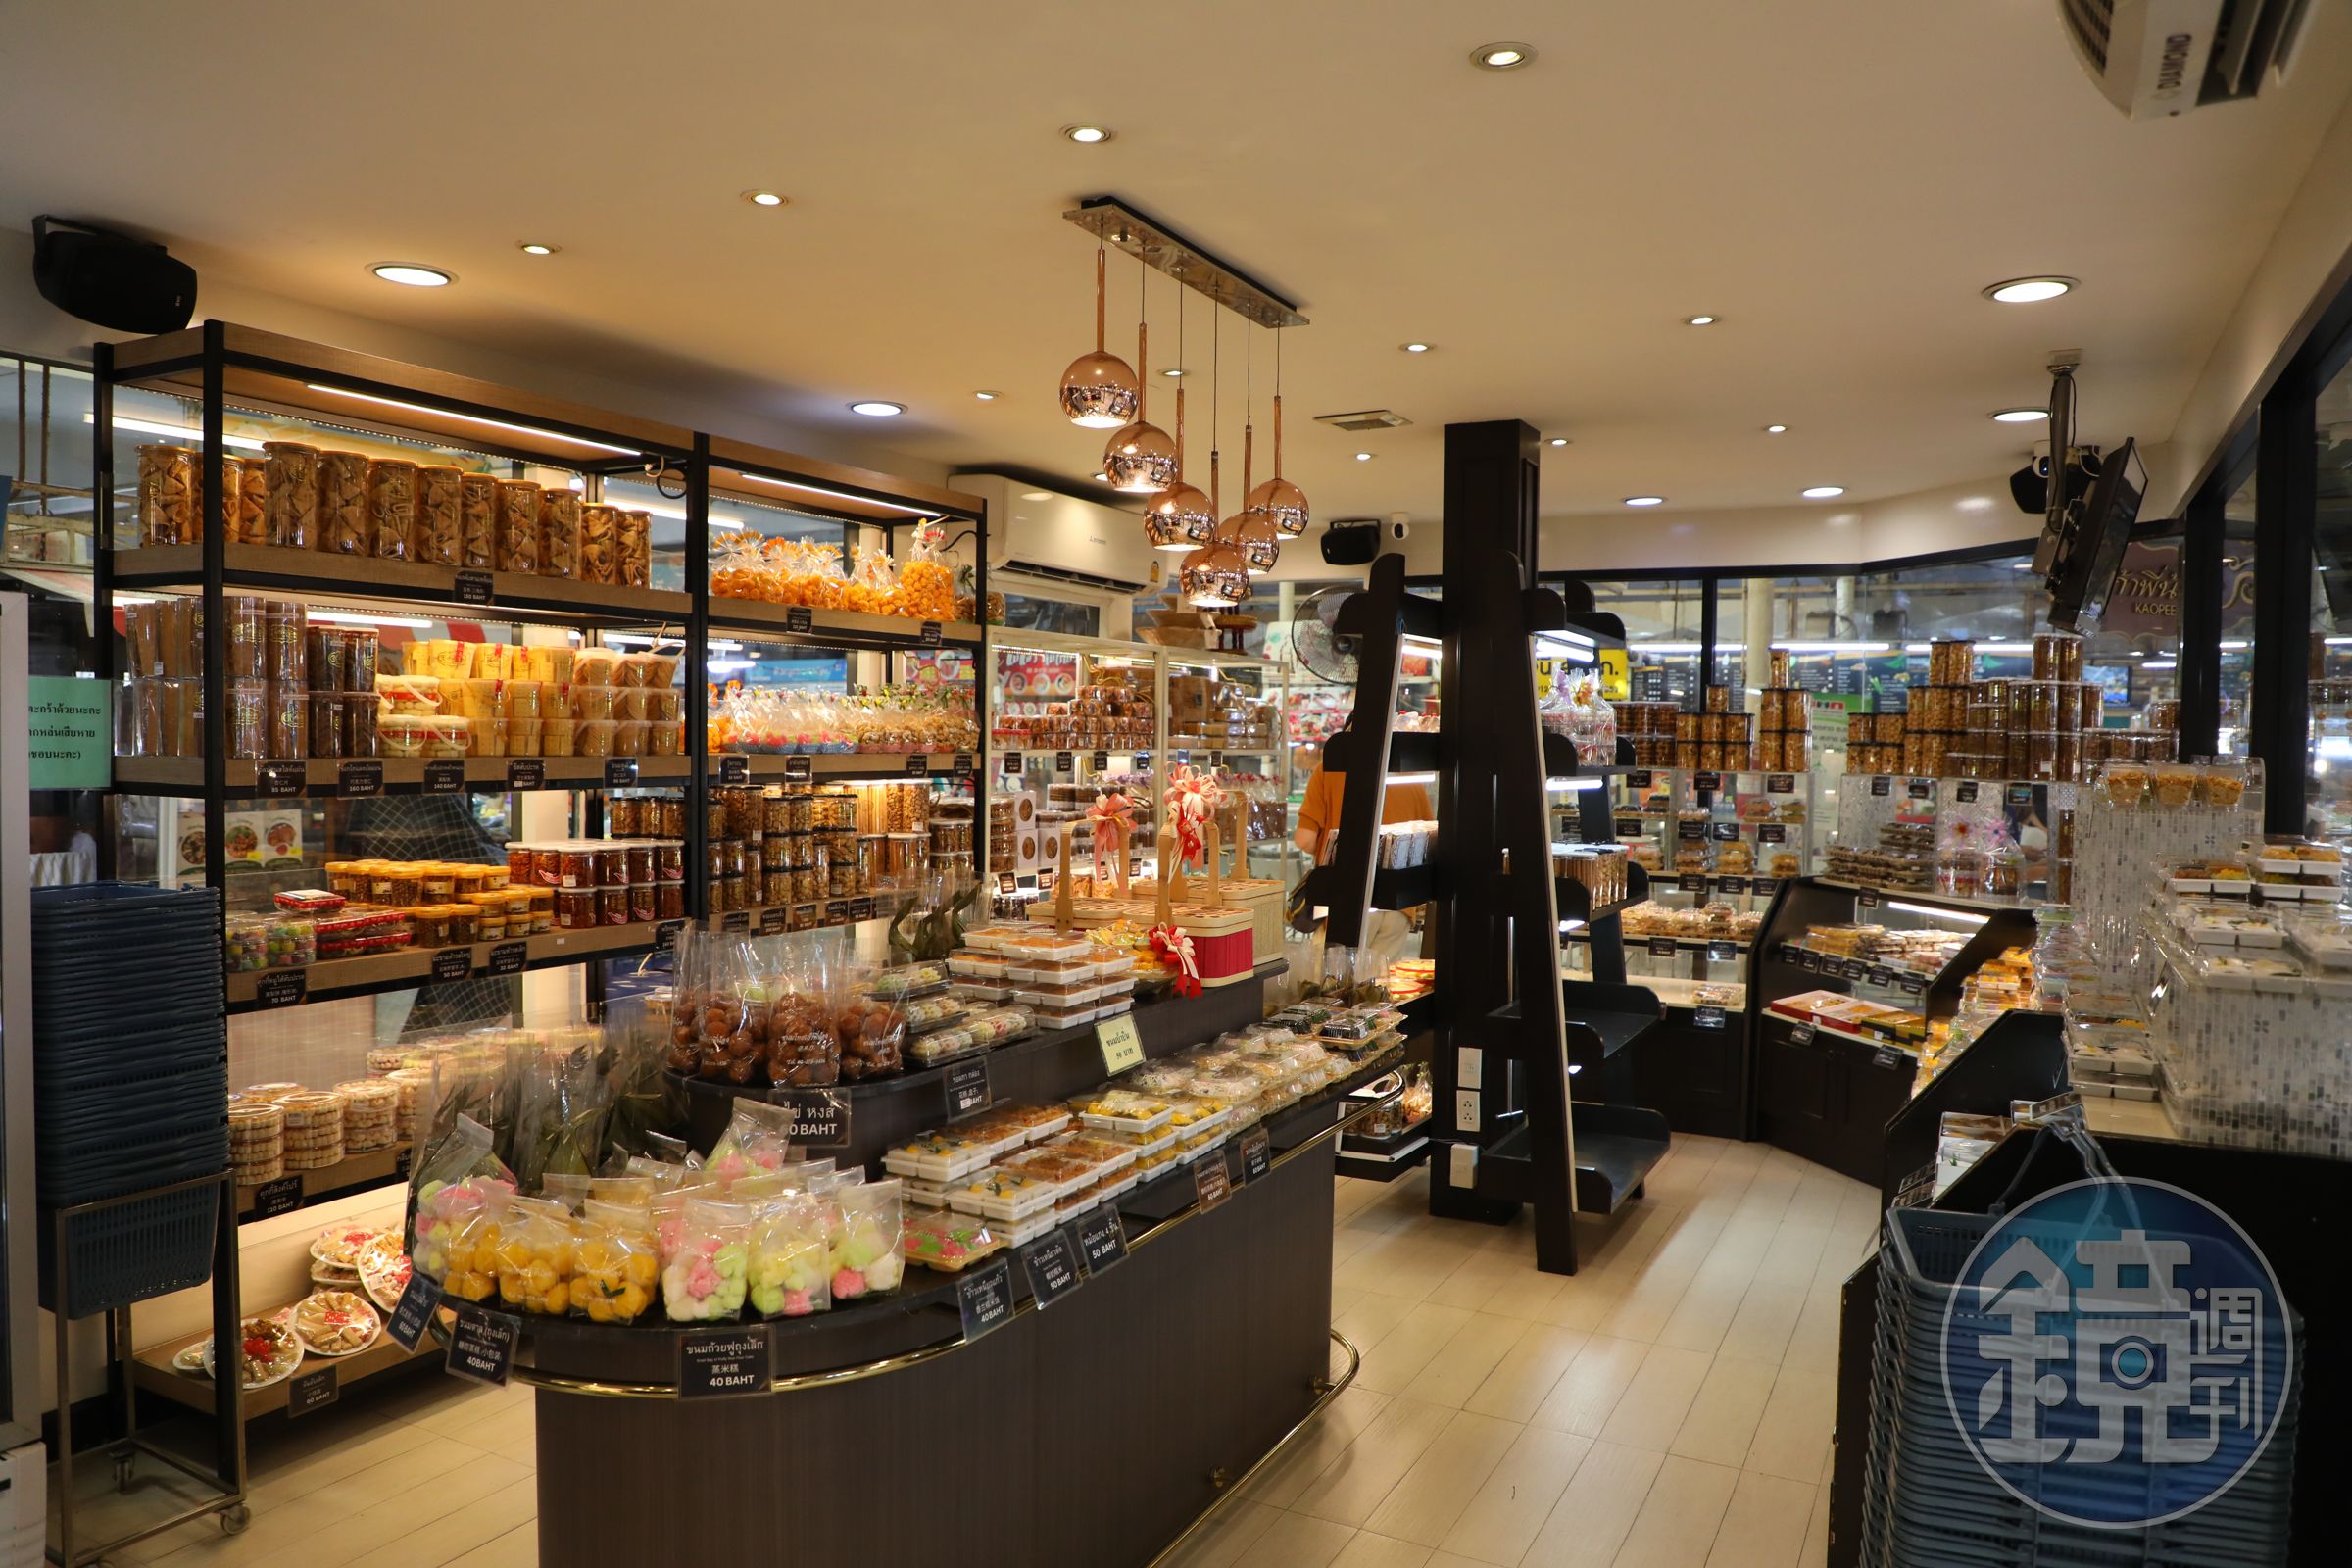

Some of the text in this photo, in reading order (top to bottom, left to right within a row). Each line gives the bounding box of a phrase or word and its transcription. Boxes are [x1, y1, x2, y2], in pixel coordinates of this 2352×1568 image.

[2135, 603, 2177, 616] KAOPEE
[801, 1123, 838, 1135] BAHT
[278, 1201, 294, 1210] BAHT
[1092, 1239, 1117, 1259] 50 BAHT
[710, 1374, 755, 1387] 40 BAHT
[315, 1392, 329, 1401] BAHT
